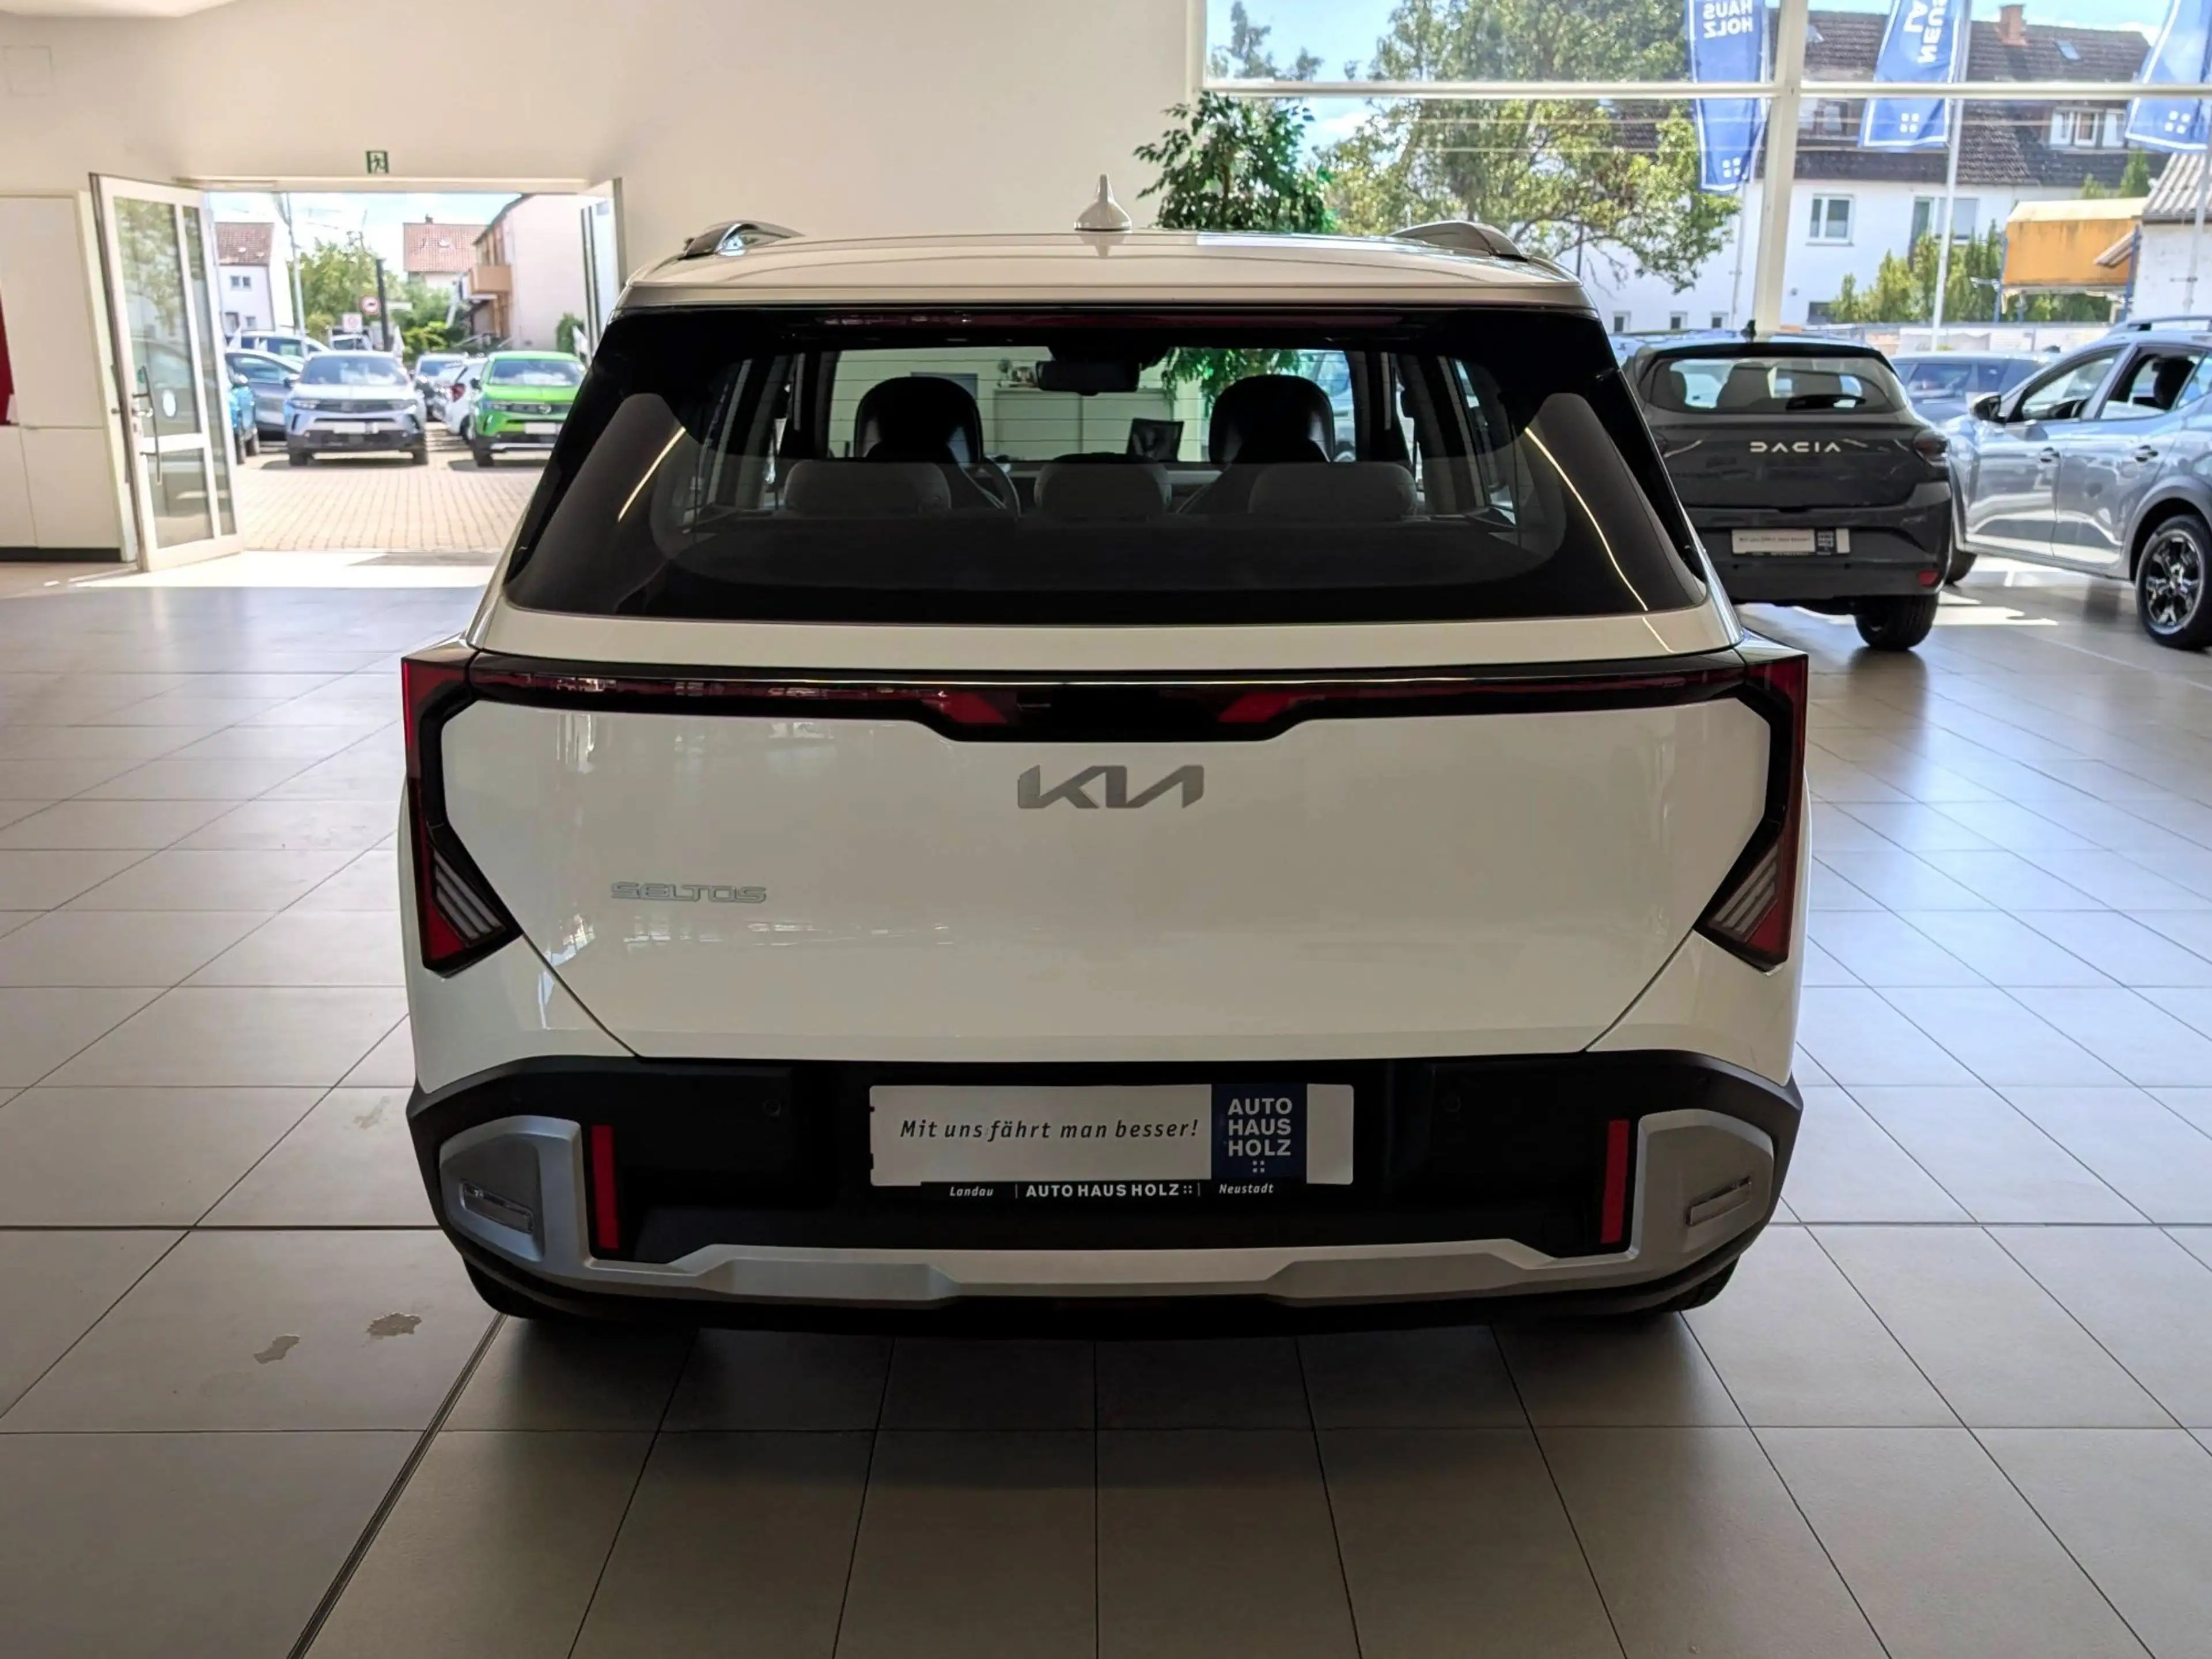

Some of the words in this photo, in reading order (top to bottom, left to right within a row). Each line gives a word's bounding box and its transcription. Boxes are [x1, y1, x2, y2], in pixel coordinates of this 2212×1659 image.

[1749, 441, 1841, 453] DACIA
[1017, 764, 1205, 809] KIA
[611, 881, 767, 903] SELTOS
[1228, 1097, 1293, 1115] AUTO
[900, 1119, 938, 1138] Mit
[944, 1124, 983, 1138] uns
[987, 1120, 1051, 1142] fährt
[1060, 1124, 1107, 1138] man
[1115, 1119, 1199, 1138] besser!
[1228, 1118, 1291, 1136] HAUS
[1228, 1139, 1291, 1157] HOLZ
[949, 1186, 994, 1197] Landau
[1131, 1183, 1179, 1196] HOLZ
[1218, 1183, 1274, 1194] Neustadt
